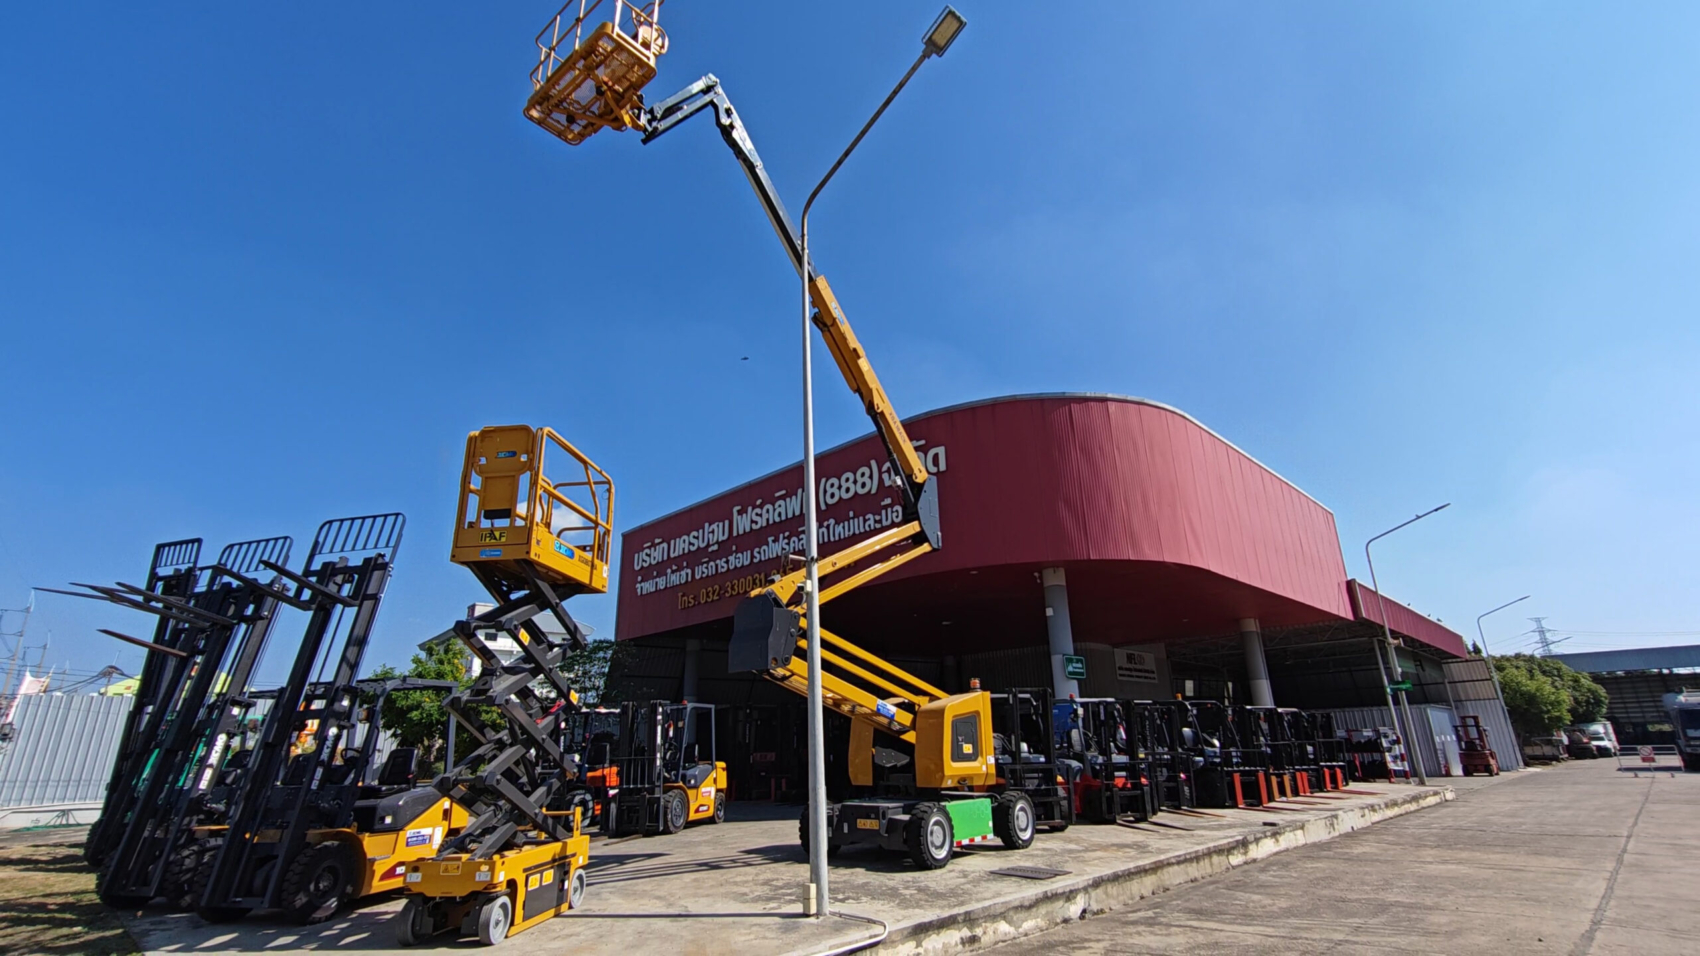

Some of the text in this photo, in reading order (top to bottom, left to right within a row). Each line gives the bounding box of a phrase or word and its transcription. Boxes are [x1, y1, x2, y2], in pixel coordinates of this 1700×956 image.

[480, 531, 506, 542] IPAF
[634, 538, 668, 571] บริษัท
[670, 519, 729, 558] นครปฐม
[733, 487, 805, 537] โฟร์คลิฟ
[819, 459, 879, 510] (888)
